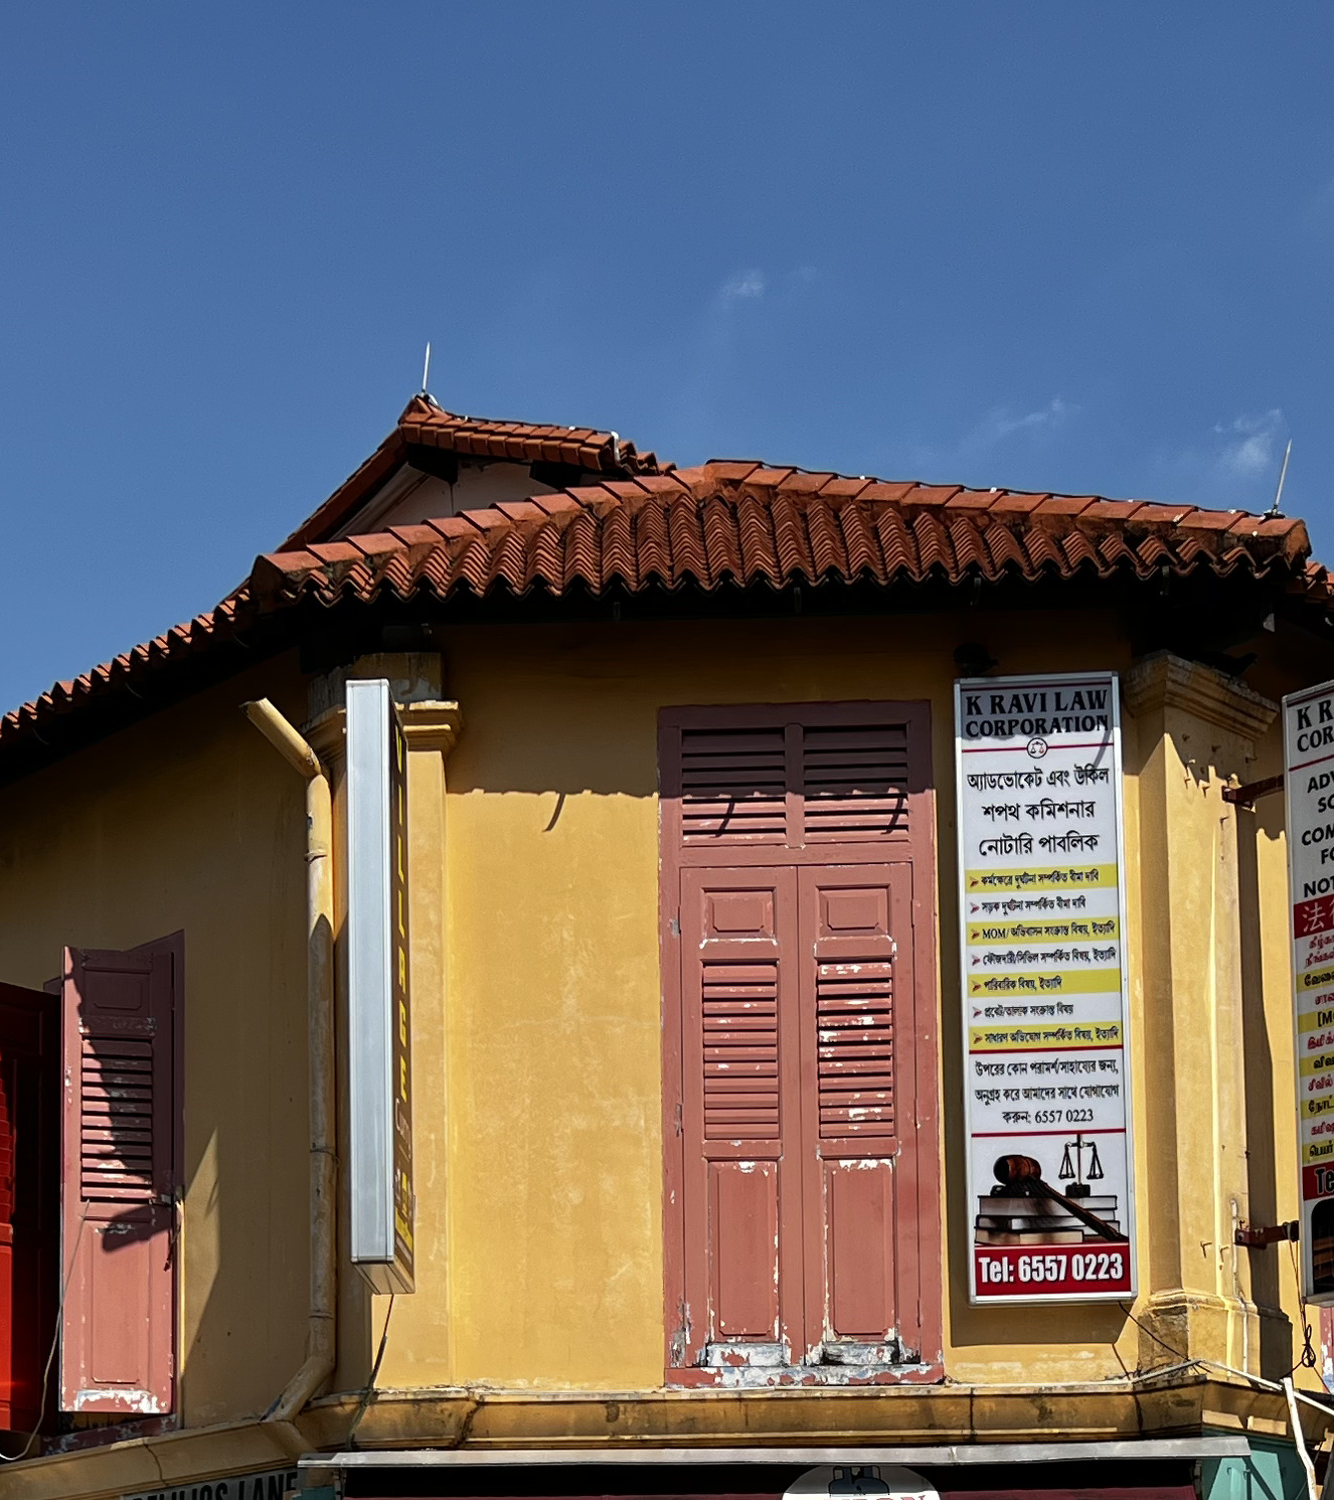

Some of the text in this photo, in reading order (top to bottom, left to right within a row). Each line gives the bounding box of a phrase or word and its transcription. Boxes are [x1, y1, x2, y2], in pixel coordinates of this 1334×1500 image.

[966, 689, 1107, 716] K RAVI LAW
[966, 715, 1109, 738] CORPORATION
[1297, 706, 1312, 731] K
[1046, 770, 1070, 787] এবং
[1074, 763, 1109, 785] উকিল
[982, 798, 1096, 822] শপথ কমিশনার
[979, 830, 1100, 856] নোটারি পাবলিক
[1035, 1109, 1094, 1124] 6557 0223
[978, 1253, 1124, 1283] Tel: 6557 0223
